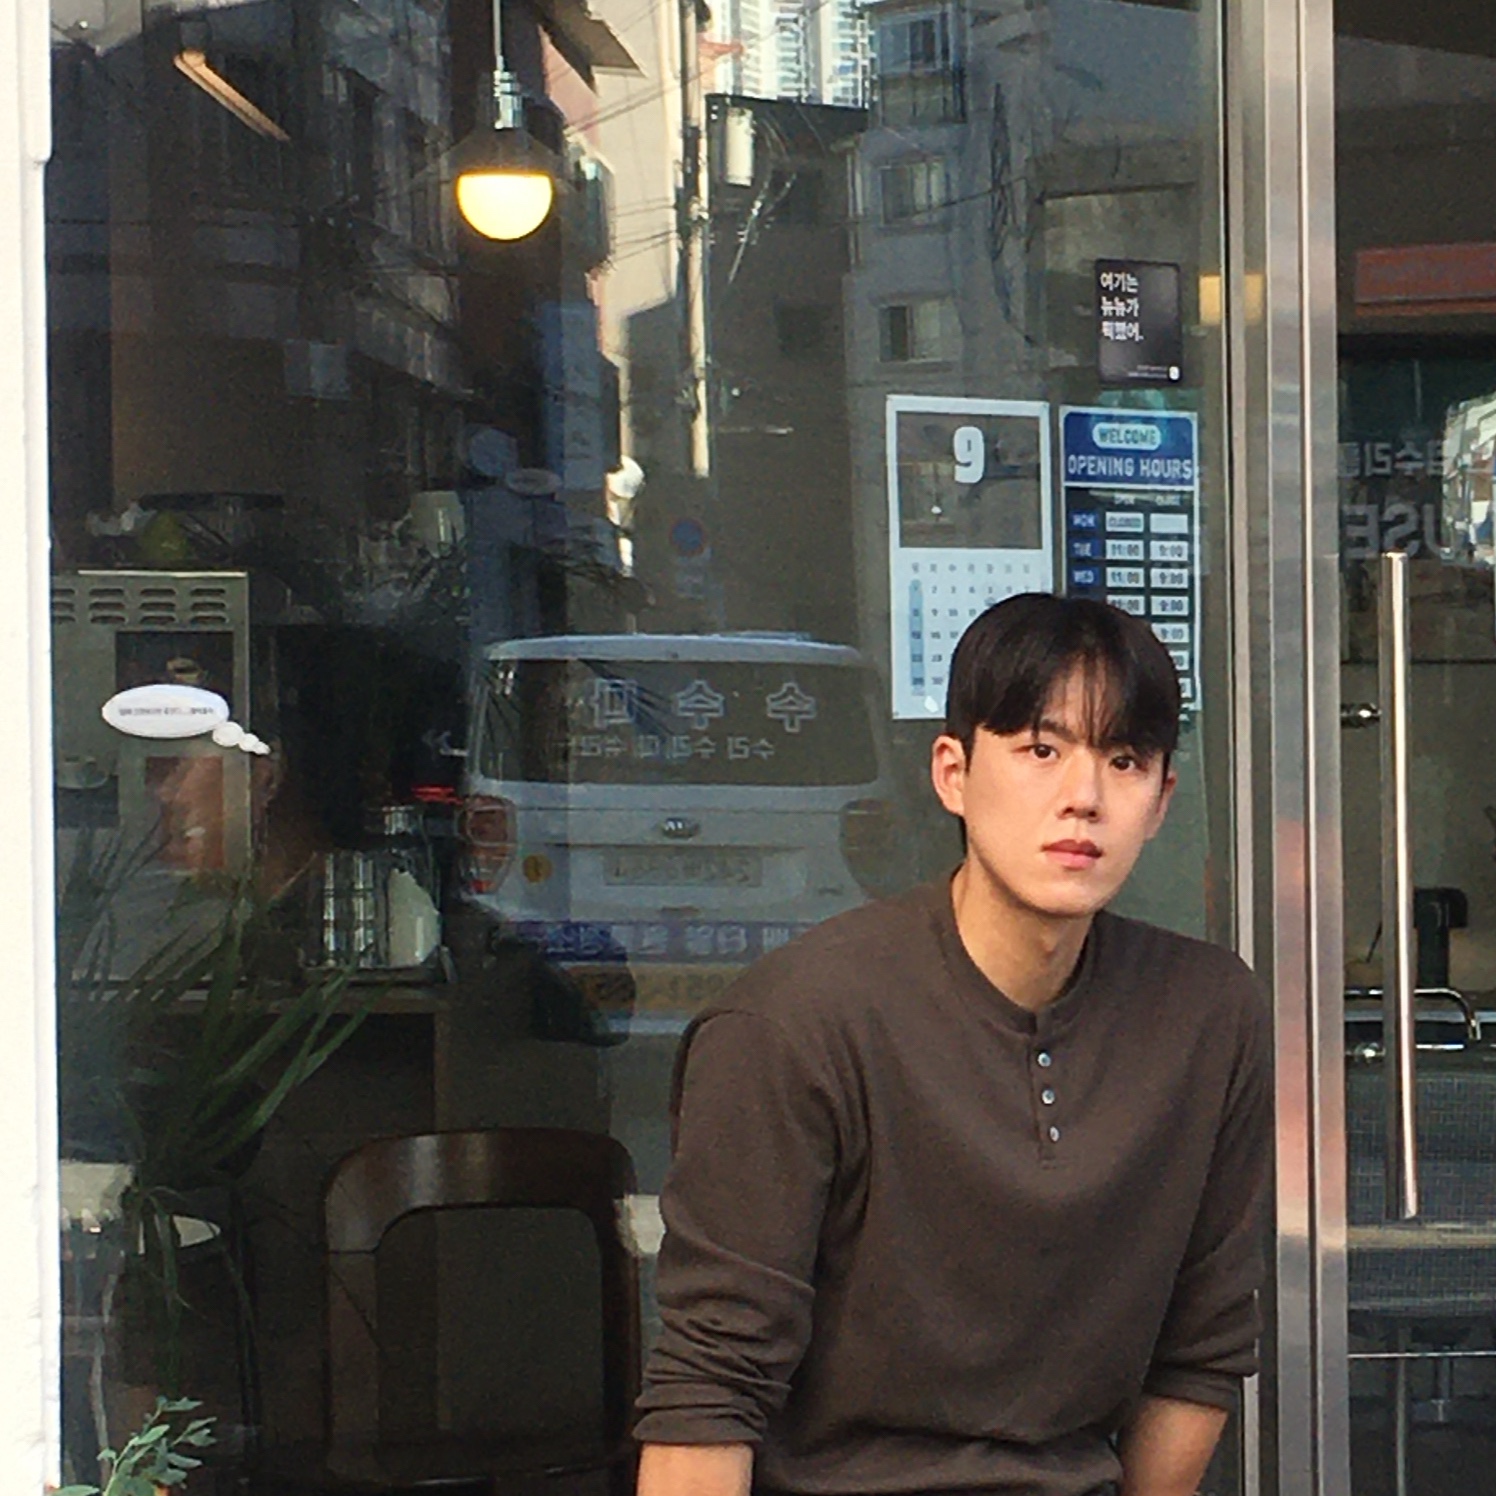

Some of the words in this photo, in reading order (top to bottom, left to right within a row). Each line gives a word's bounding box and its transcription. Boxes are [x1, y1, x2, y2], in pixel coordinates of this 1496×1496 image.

[1100, 272, 1139, 293] 여기는
[1098, 427, 1157, 445] WELCOME
[953, 426, 985, 483] 9
[1068, 454, 1134, 477] OPENING
[1140, 458, 1193, 480] HOURS
[1072, 514, 1096, 528] MON
[1073, 570, 1094, 584] WED
